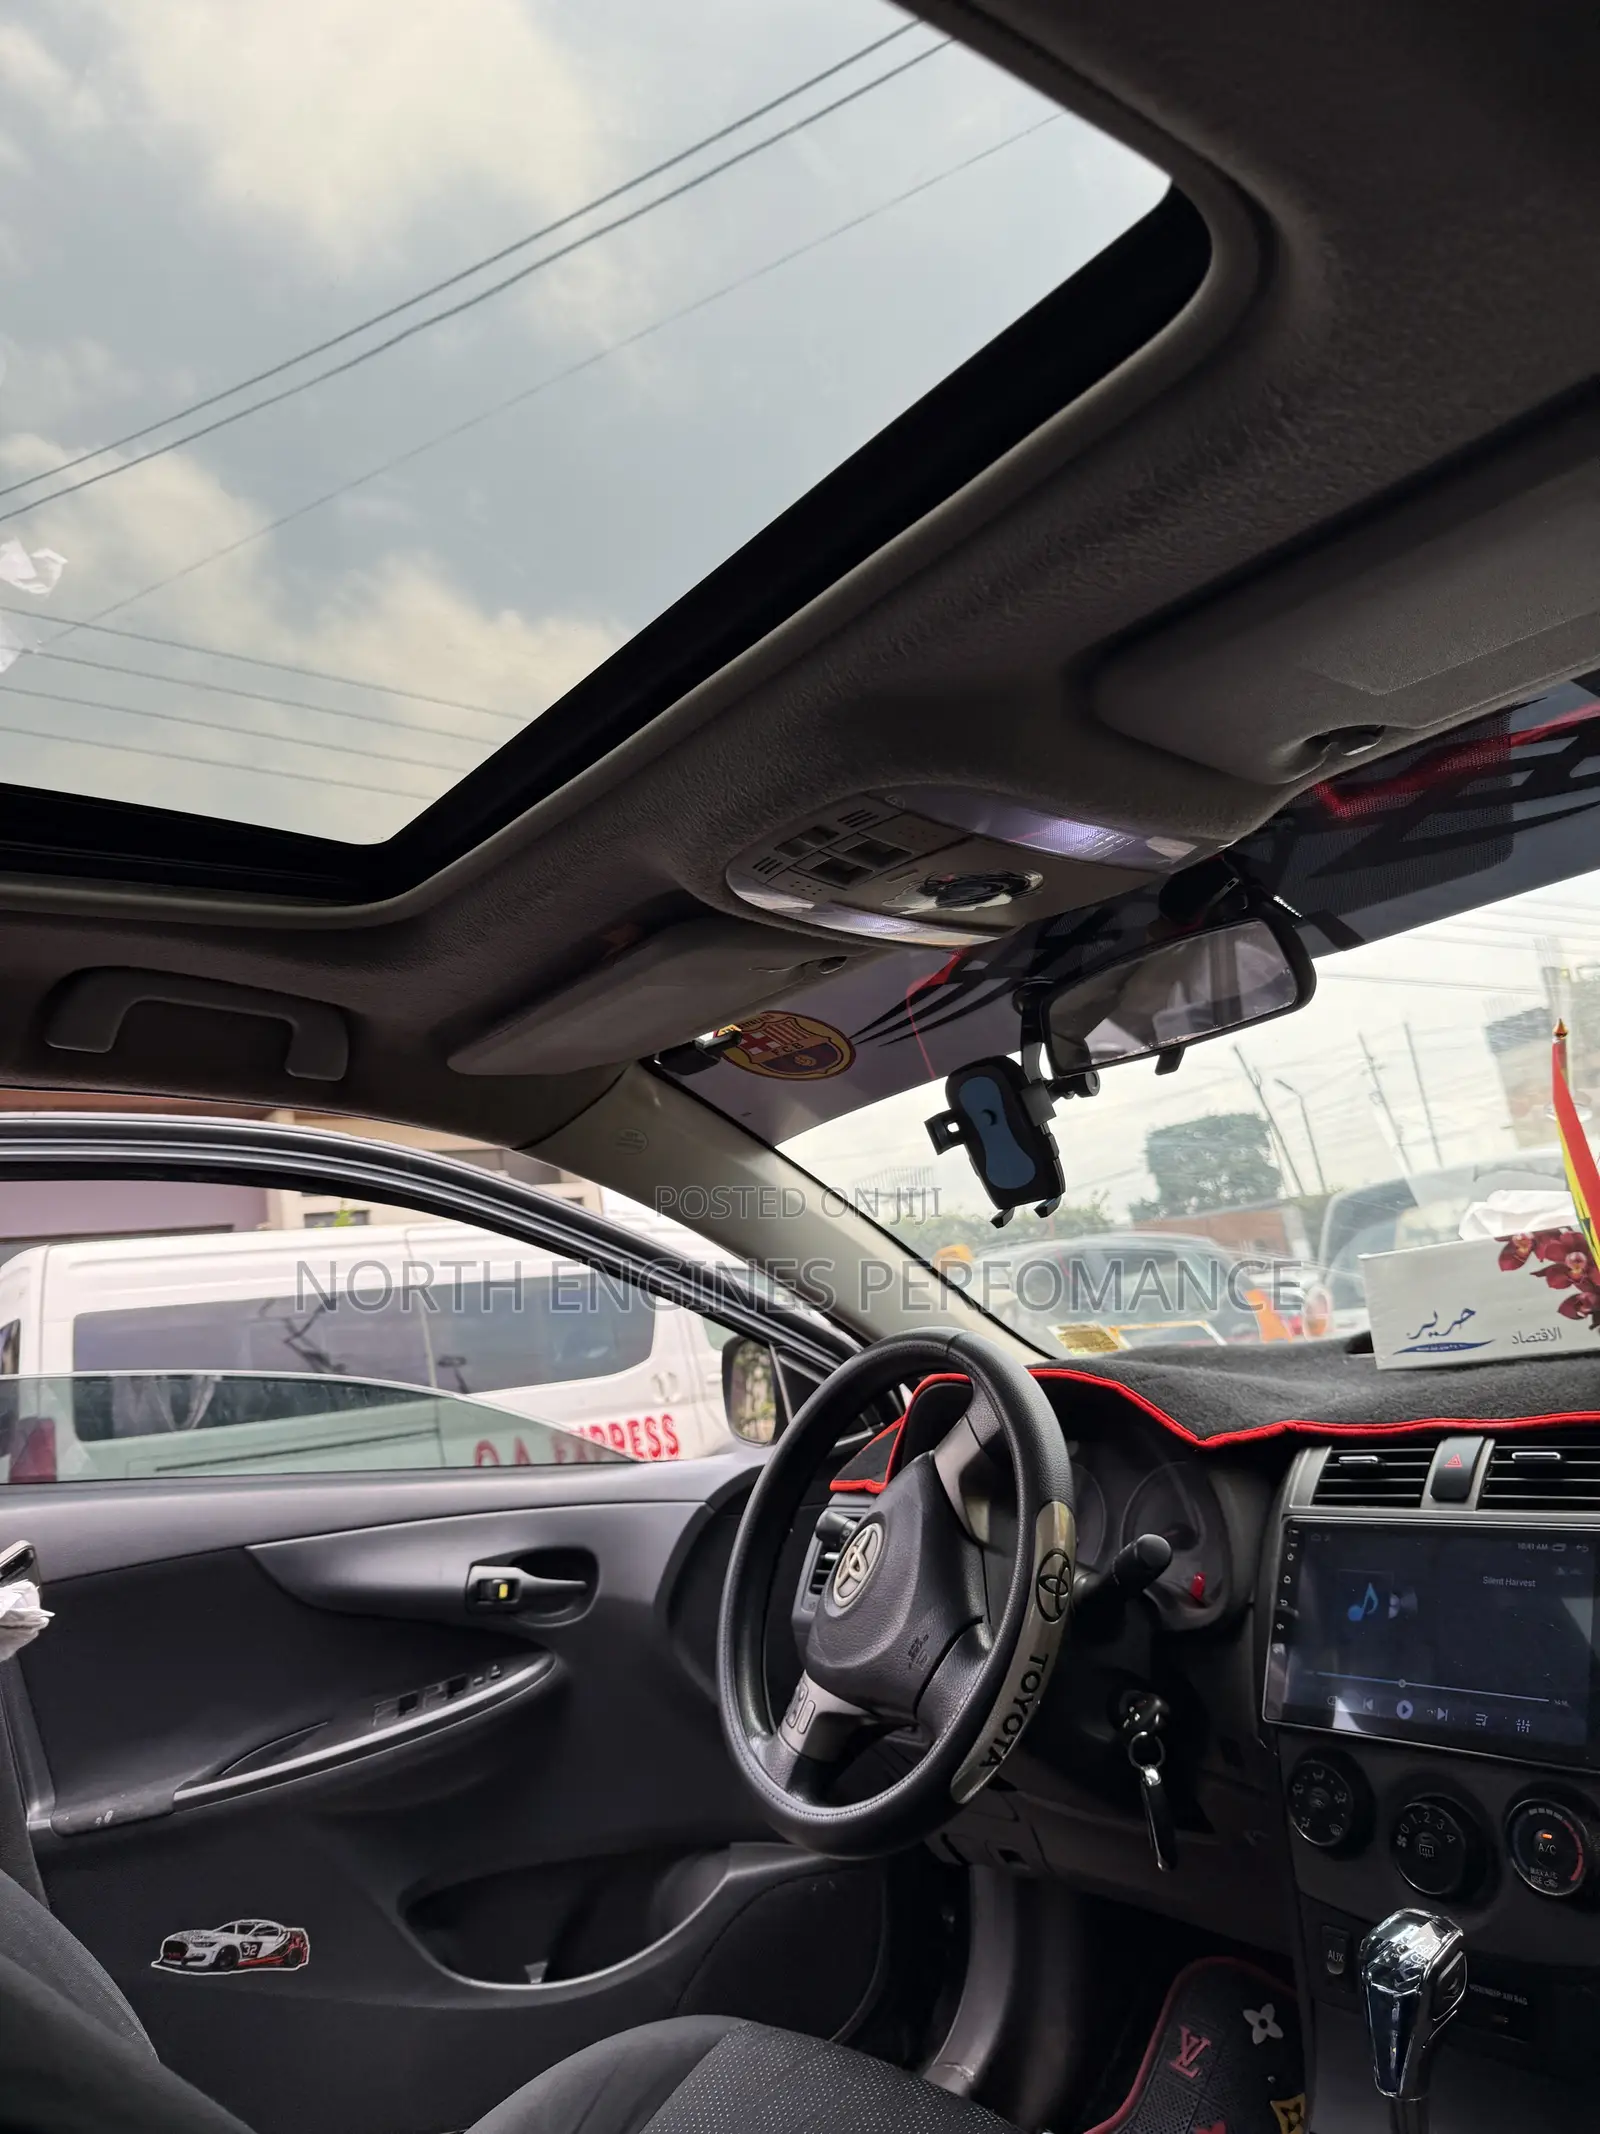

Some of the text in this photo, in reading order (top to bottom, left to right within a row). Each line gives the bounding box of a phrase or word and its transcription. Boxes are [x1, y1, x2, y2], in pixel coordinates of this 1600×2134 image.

[1406, 1307, 1476, 1340] حرير
[1511, 1326, 1562, 1345] الاقتصاد
[979, 1652, 1049, 1769] TOYOTA
[1538, 1842, 1557, 1856] A/C
[242, 1943, 259, 1957] 32
